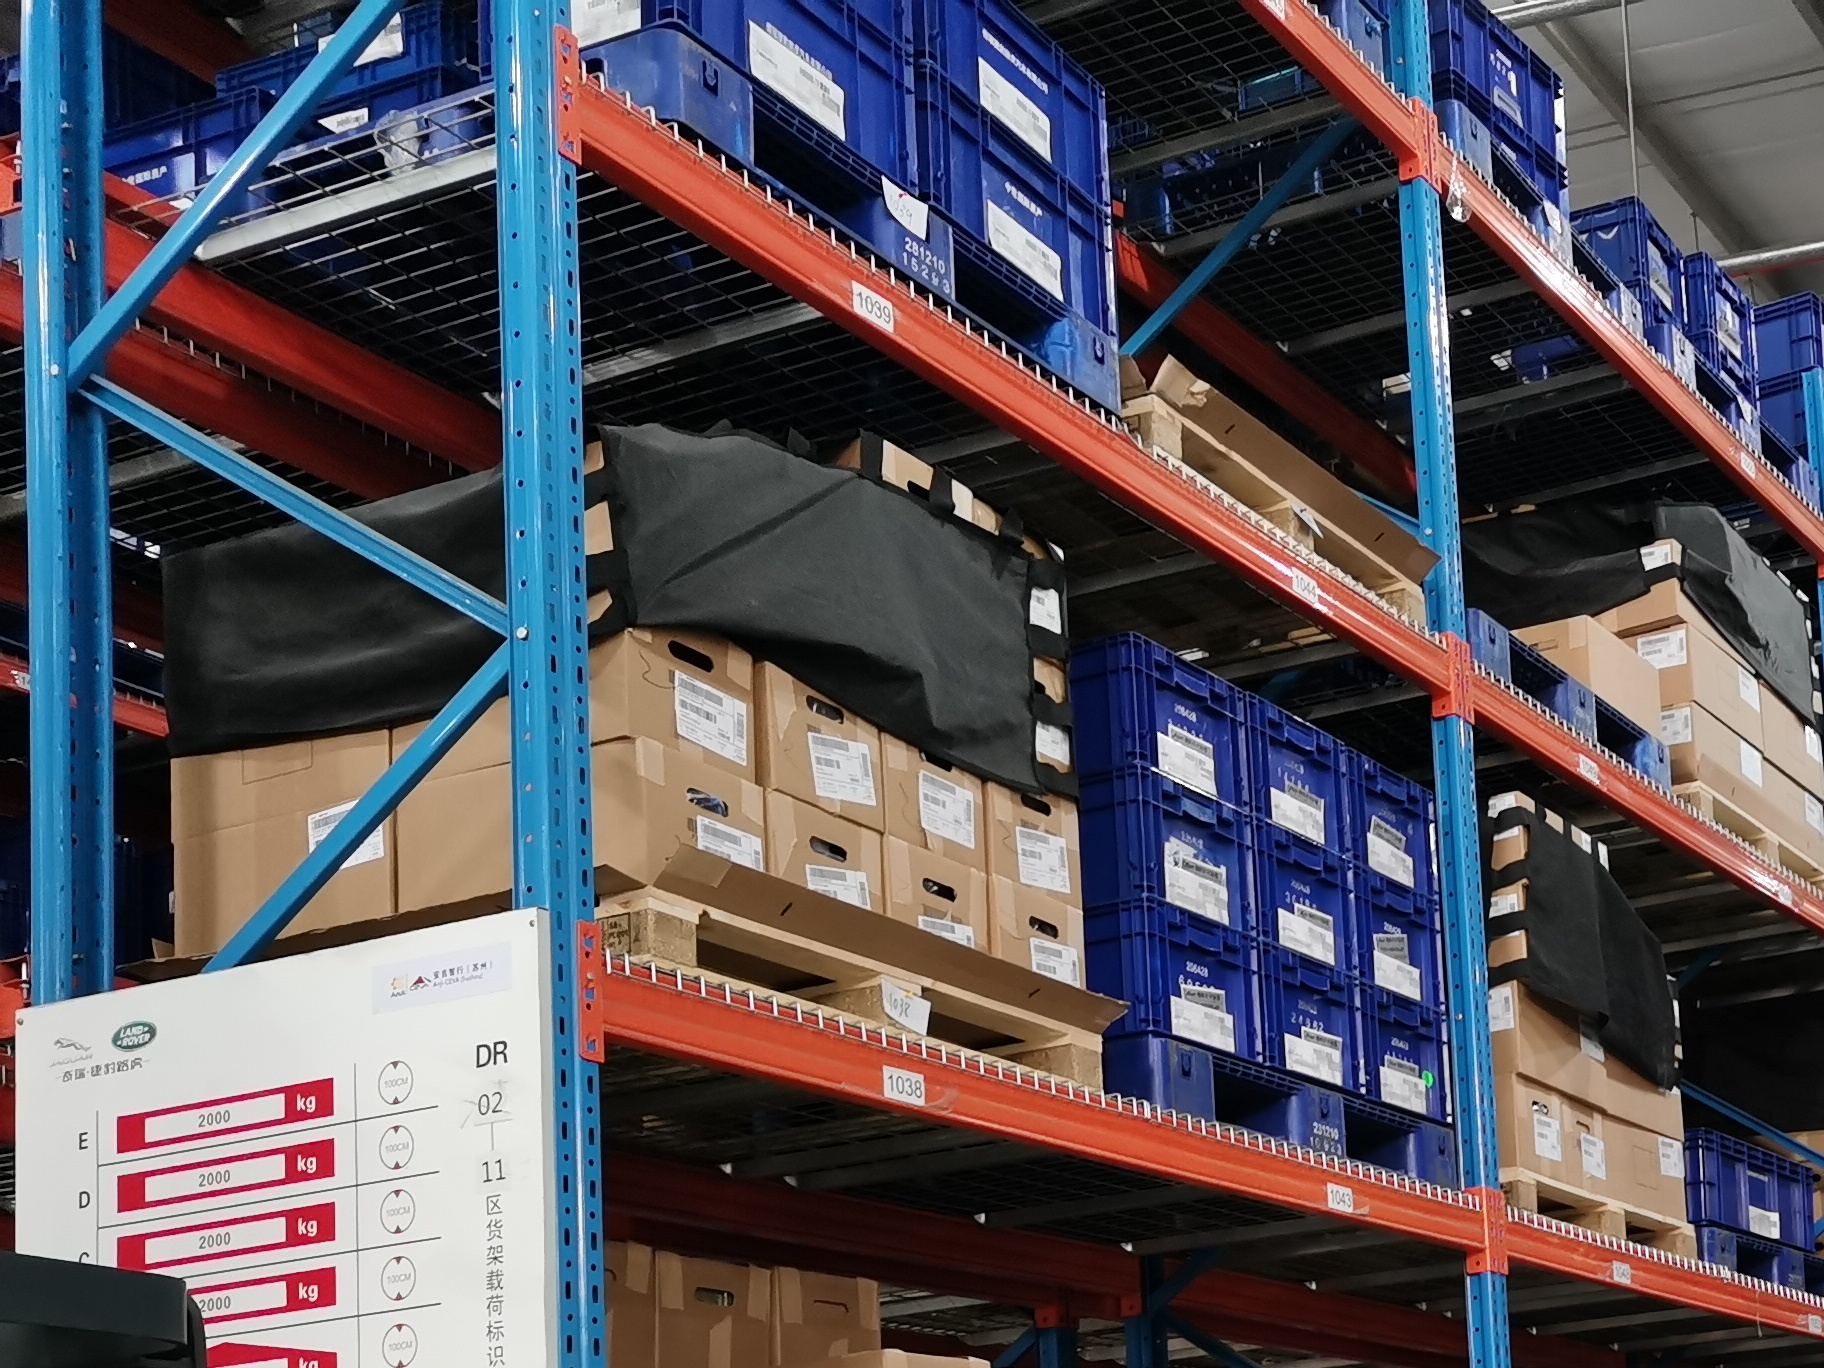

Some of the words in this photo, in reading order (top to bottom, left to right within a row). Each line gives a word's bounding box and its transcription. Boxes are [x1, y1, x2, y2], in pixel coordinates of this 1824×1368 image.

[856, 292, 892, 325] 1039
[475, 1040, 509, 1068] DR
[887, 1074, 923, 1099] 1038
[198, 1109, 231, 1128] 2000
[296, 1093, 316, 1113] kg
[477, 1091, 503, 1116] 02
[78, 1132, 89, 1150] E
[198, 1169, 231, 1188] 2000
[297, 1154, 317, 1173] kg
[481, 1158, 507, 1183] 11
[78, 1190, 91, 1209] D
[1330, 1189, 1352, 1208] 1043
[198, 1232, 231, 1250] 2000
[297, 1217, 318, 1237] kg
[485, 1193, 506, 1368] 区货架载荷标识
[199, 1296, 231, 1313] 2000
[298, 1282, 319, 1302] kg
